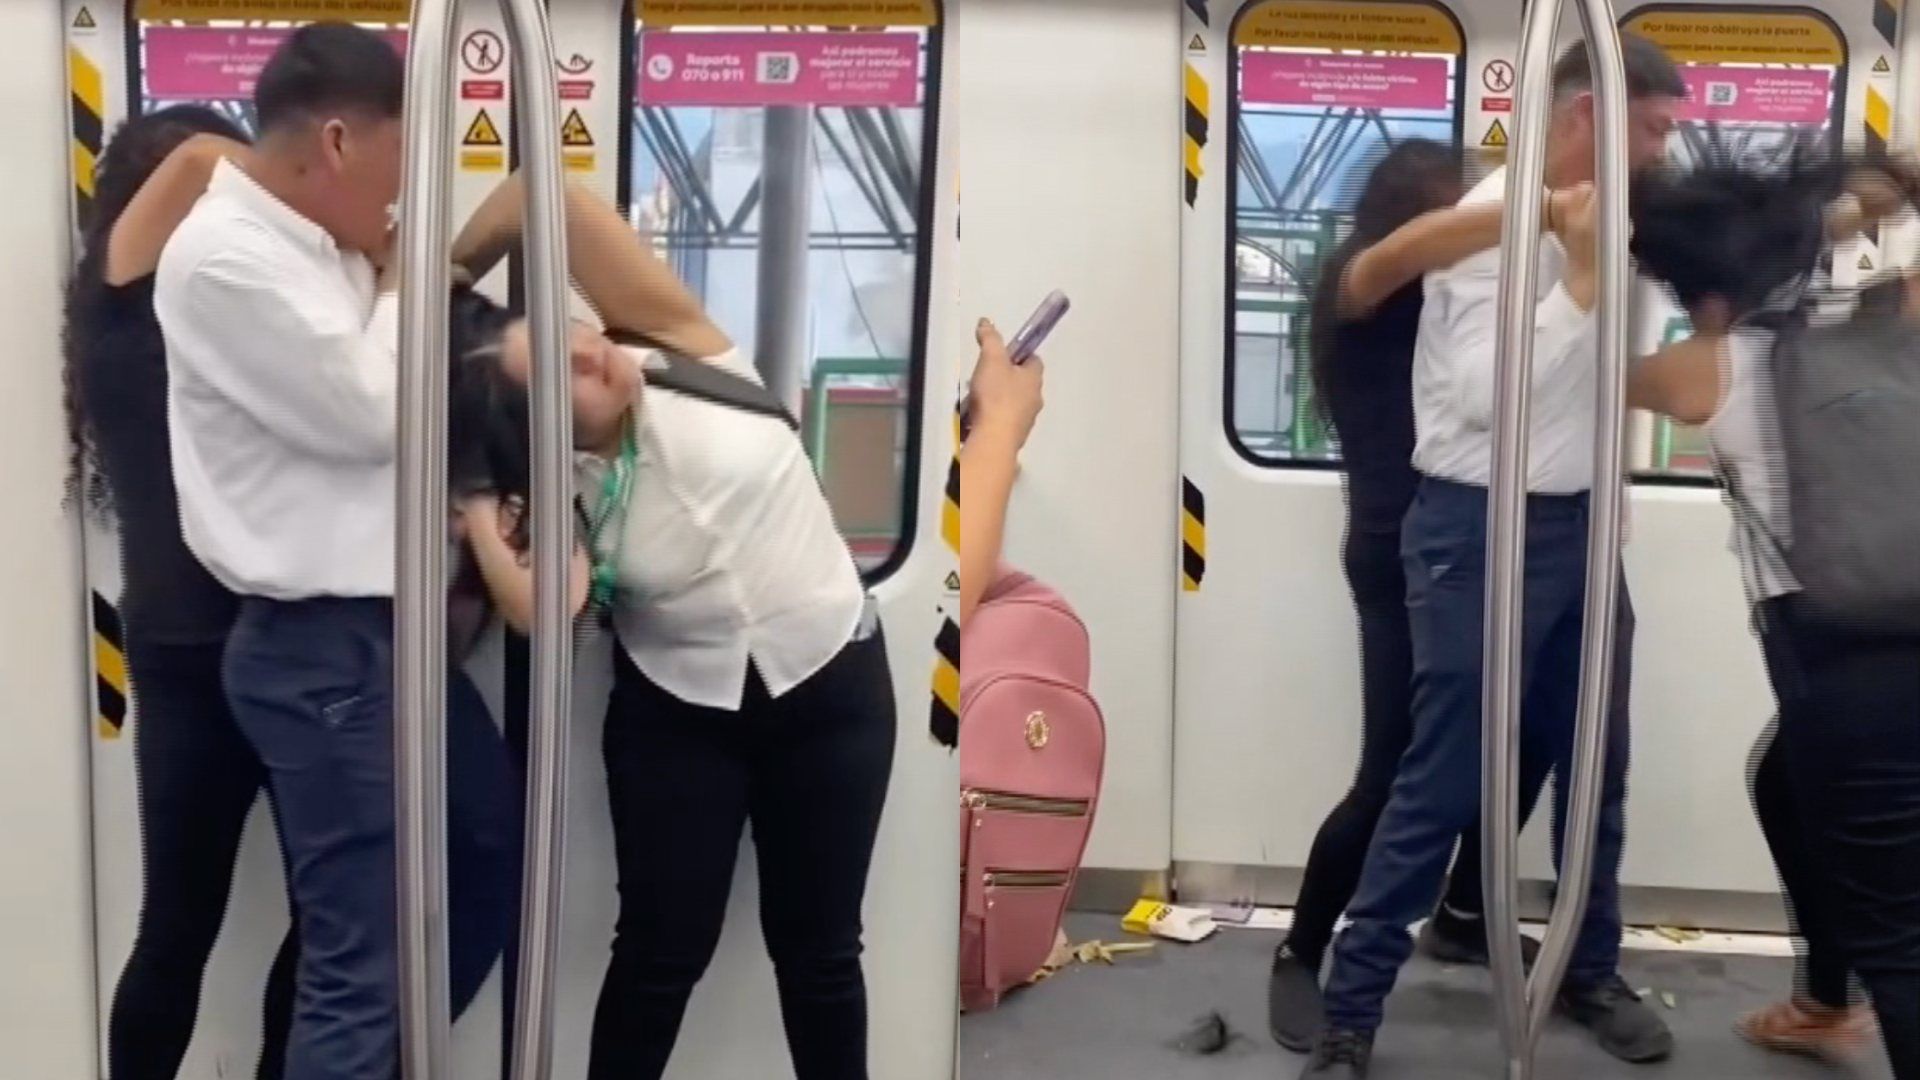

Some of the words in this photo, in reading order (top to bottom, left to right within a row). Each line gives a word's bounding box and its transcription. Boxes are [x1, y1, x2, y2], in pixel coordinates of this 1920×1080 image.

[1643, 22, 1663, 33] Por
[1694, 25, 1709, 34] no
[686, 54, 740, 66] Reporta
[868, 57, 912, 68] servicio
[681, 68, 710, 82] 070
[722, 68, 745, 82] 911
